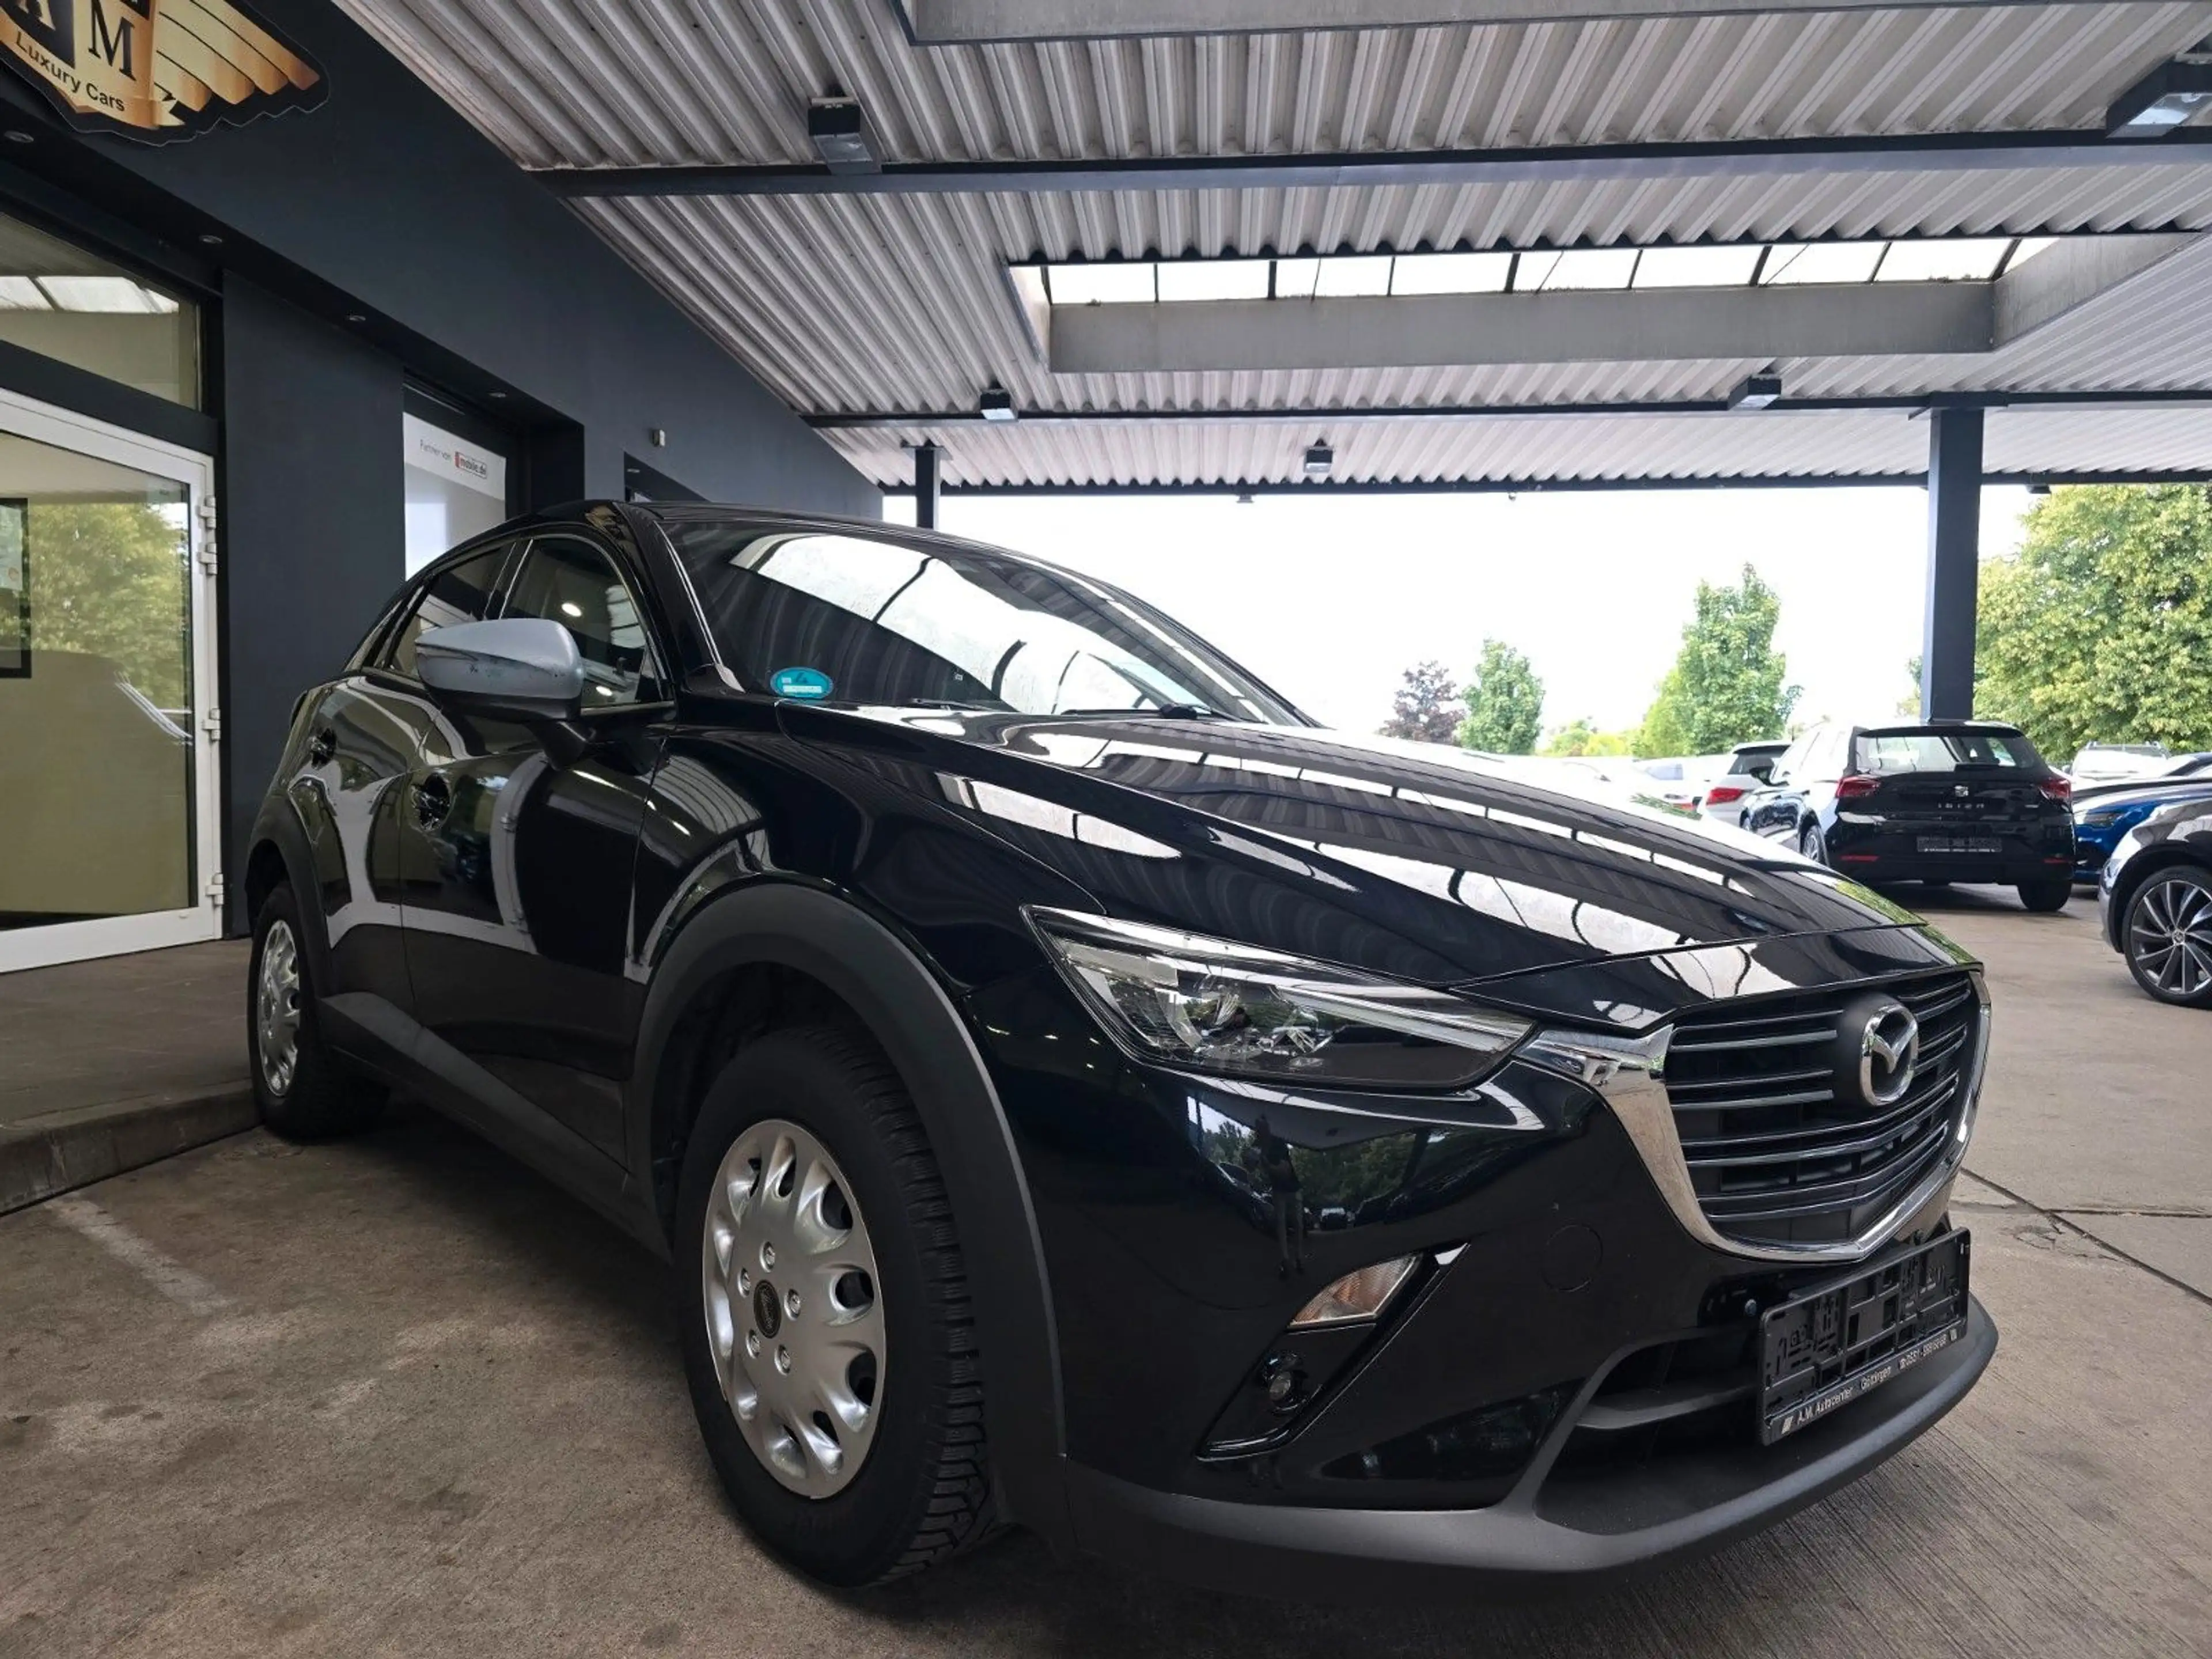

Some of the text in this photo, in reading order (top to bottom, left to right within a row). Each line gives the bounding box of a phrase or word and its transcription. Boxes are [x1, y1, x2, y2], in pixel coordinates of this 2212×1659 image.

[16, 31, 125, 112] Luxury Cars
[88, 0, 136, 81] M
